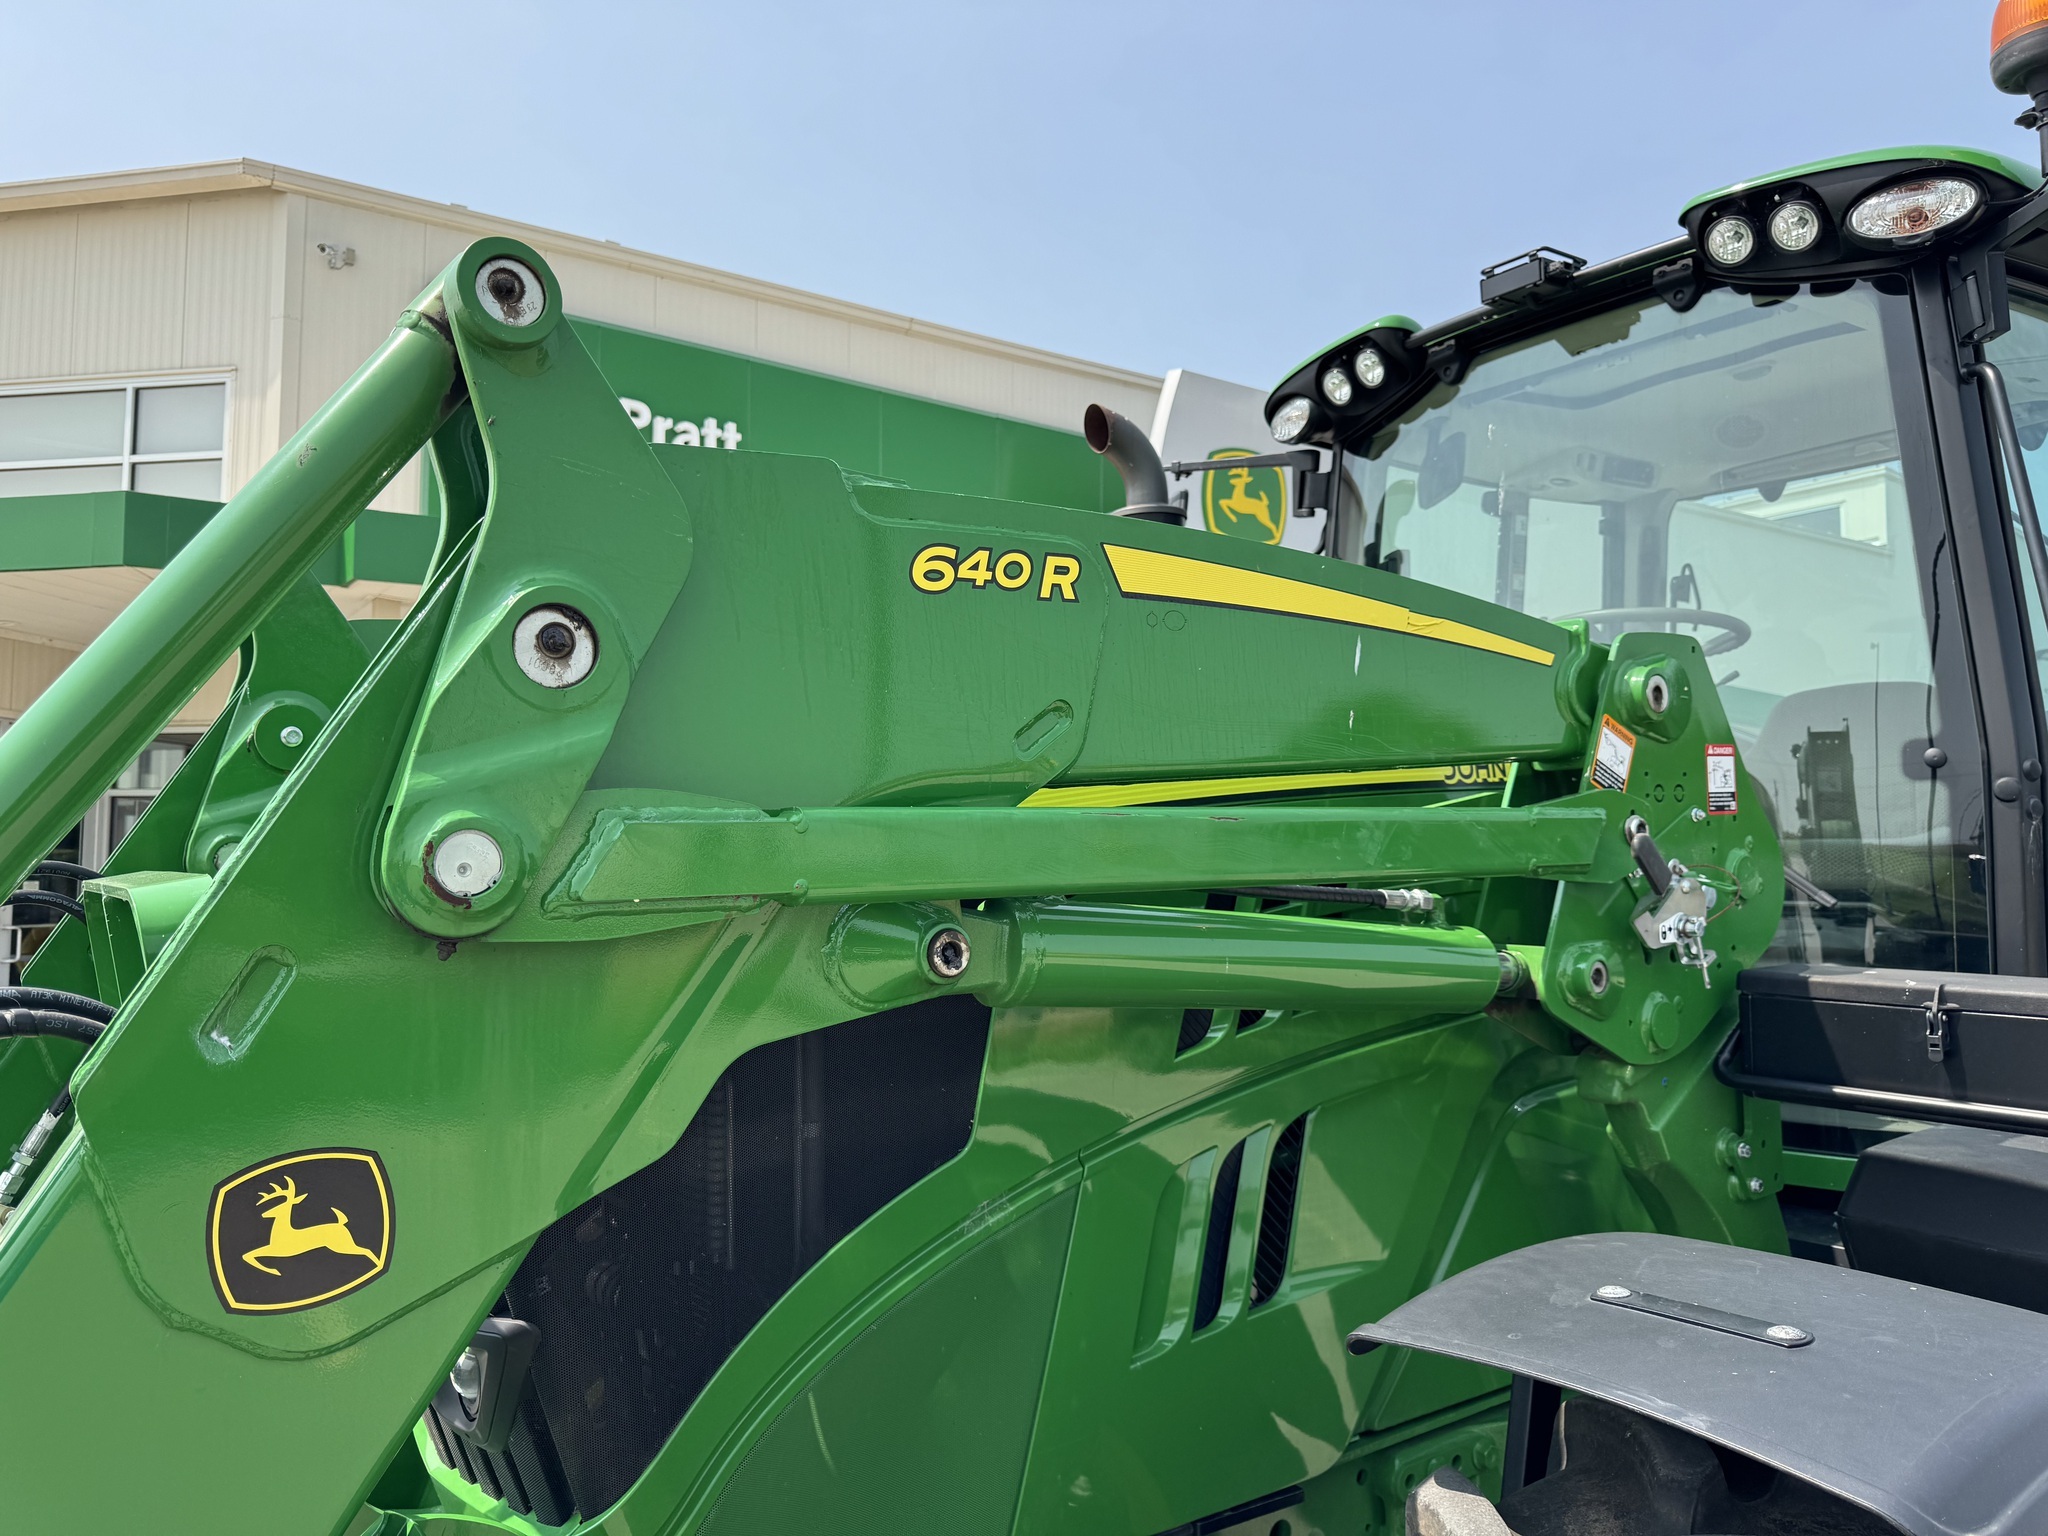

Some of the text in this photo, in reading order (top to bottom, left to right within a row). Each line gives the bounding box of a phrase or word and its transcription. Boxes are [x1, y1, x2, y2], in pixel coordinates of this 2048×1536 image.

[618, 396, 743, 450] Pratt
[1610, 723, 1634, 746] WARNING
[1713, 746, 1733, 755] DANGER
[1444, 762, 1511, 785] JOHN
[27, 894, 83, 911] ALFAGOMMA
[30, 989, 55, 1000] AT3K
